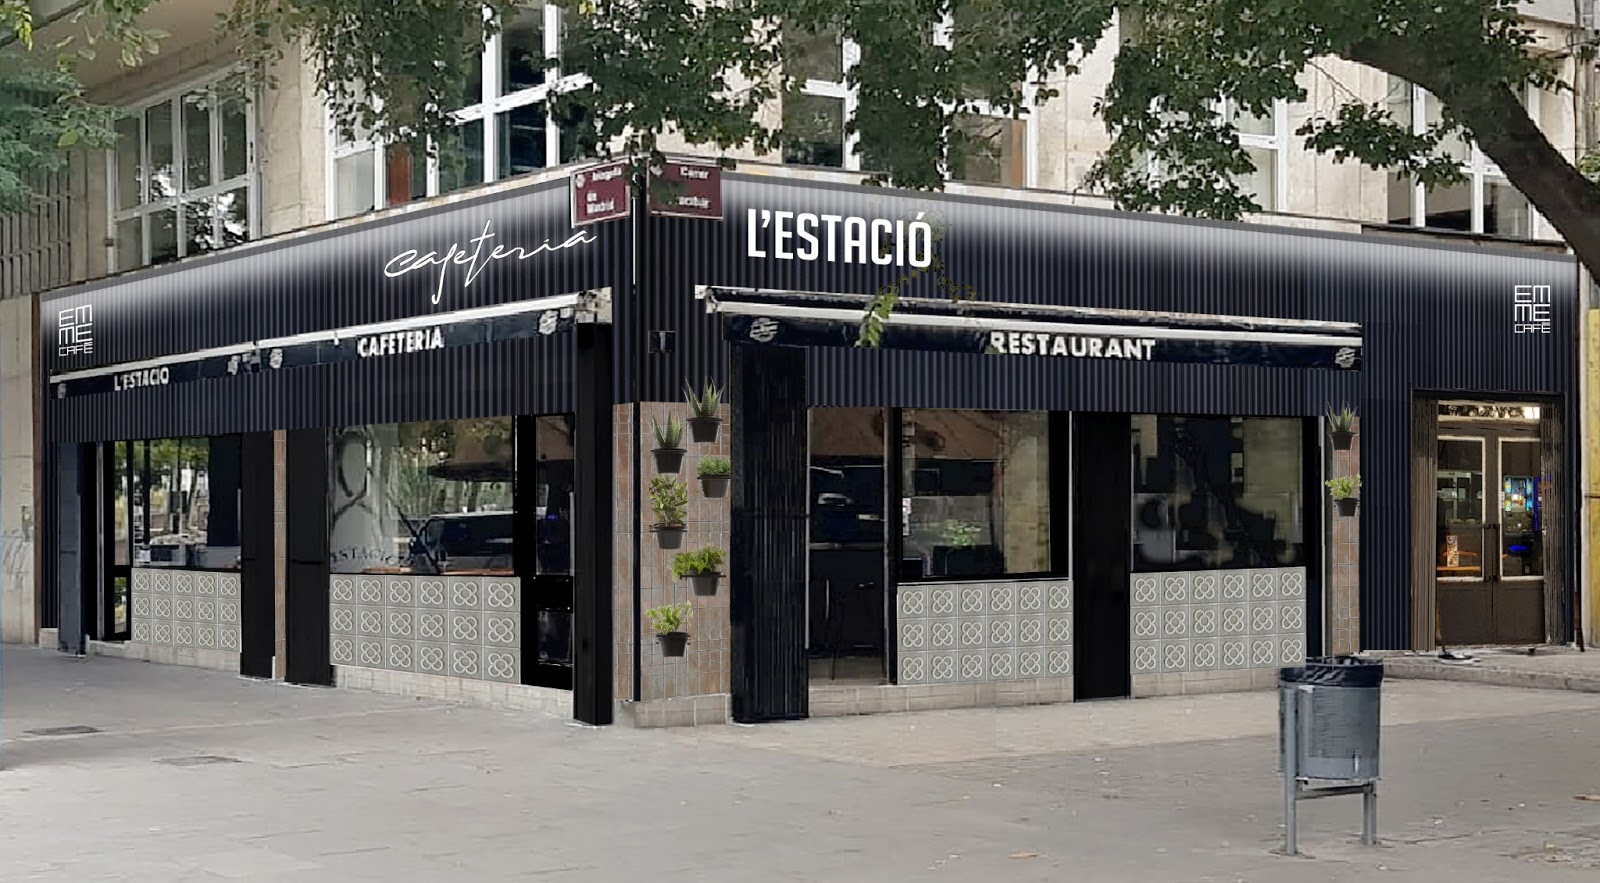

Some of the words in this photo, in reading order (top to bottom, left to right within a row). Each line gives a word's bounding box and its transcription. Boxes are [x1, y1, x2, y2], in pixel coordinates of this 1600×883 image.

[748, 208, 932, 268] L'ESTACIÓ
[358, 326, 444, 357] CAFETERIA
[989, 331, 1156, 360] RESTAURANT
